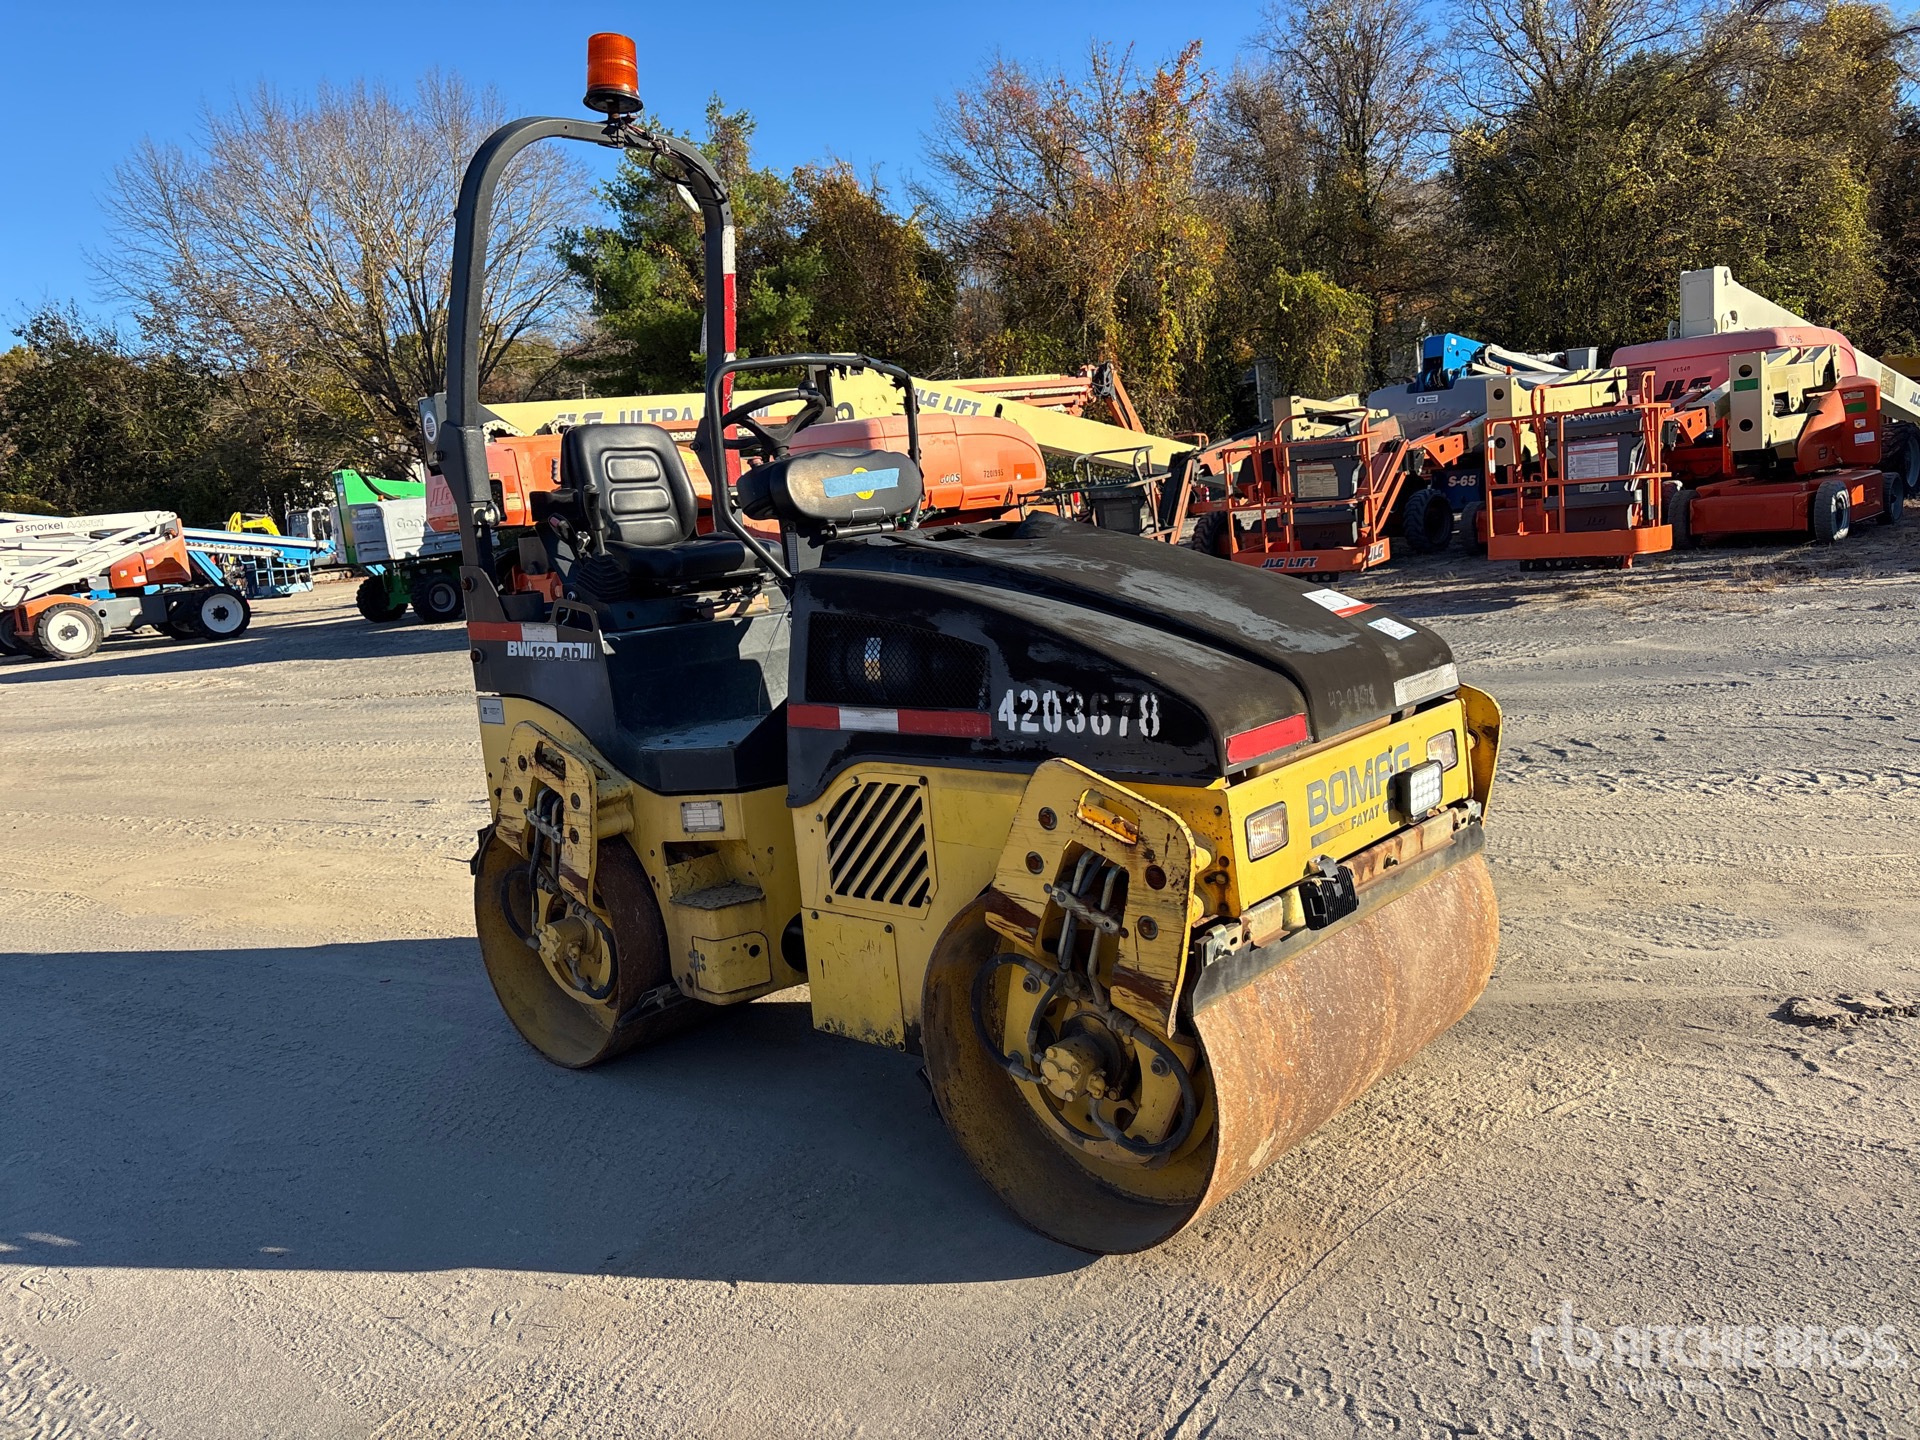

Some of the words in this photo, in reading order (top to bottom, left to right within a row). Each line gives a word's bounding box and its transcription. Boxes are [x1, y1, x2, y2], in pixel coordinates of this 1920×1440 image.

[1655, 376, 1712, 401] JLG
[916, 388, 941, 408] JLG
[943, 396, 982, 416] LIFT
[619, 407, 694, 424] ULTRA
[1448, 474, 1476, 487] S-65
[25, 521, 64, 533] snorkel
[396, 515, 425, 529] Geni
[1368, 543, 1384, 561] JLG
[1261, 557, 1285, 569] JLG
[1287, 556, 1318, 568] LIFT
[998, 689, 1160, 738] 4203678
[1306, 741, 1411, 828] BOMAG
[1350, 803, 1380, 830] FAYAT
